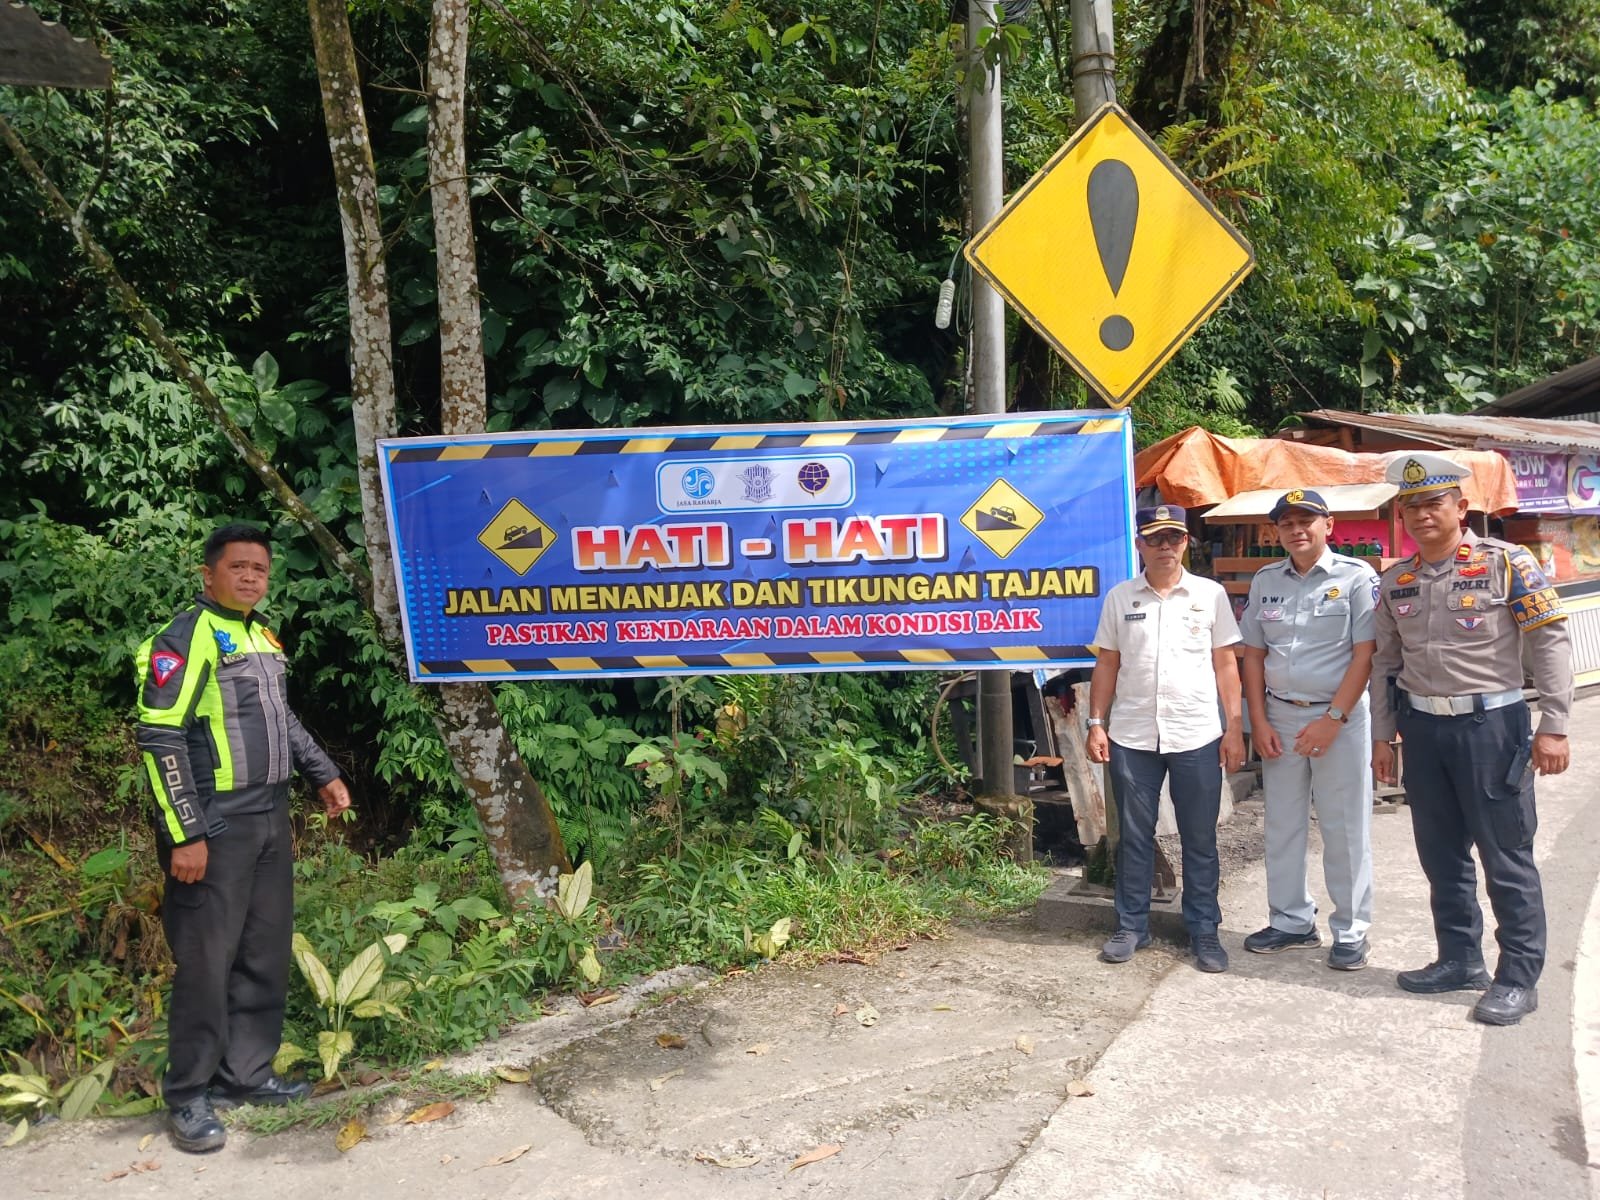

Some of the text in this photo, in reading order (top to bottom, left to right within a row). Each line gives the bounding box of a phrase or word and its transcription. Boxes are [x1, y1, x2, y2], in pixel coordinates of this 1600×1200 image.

[572, 522, 729, 570] HATI
[783, 513, 944, 563] HATI
[445, 569, 1094, 615] JALAN MENANJAK DAN TIKUNGAN TAJAM
[1452, 580, 1490, 591] POLRI
[486, 608, 1043, 645] PASTIKAN KENDARAAN DALAM KONDISI BAIK
[161, 755, 197, 826] POLISI
